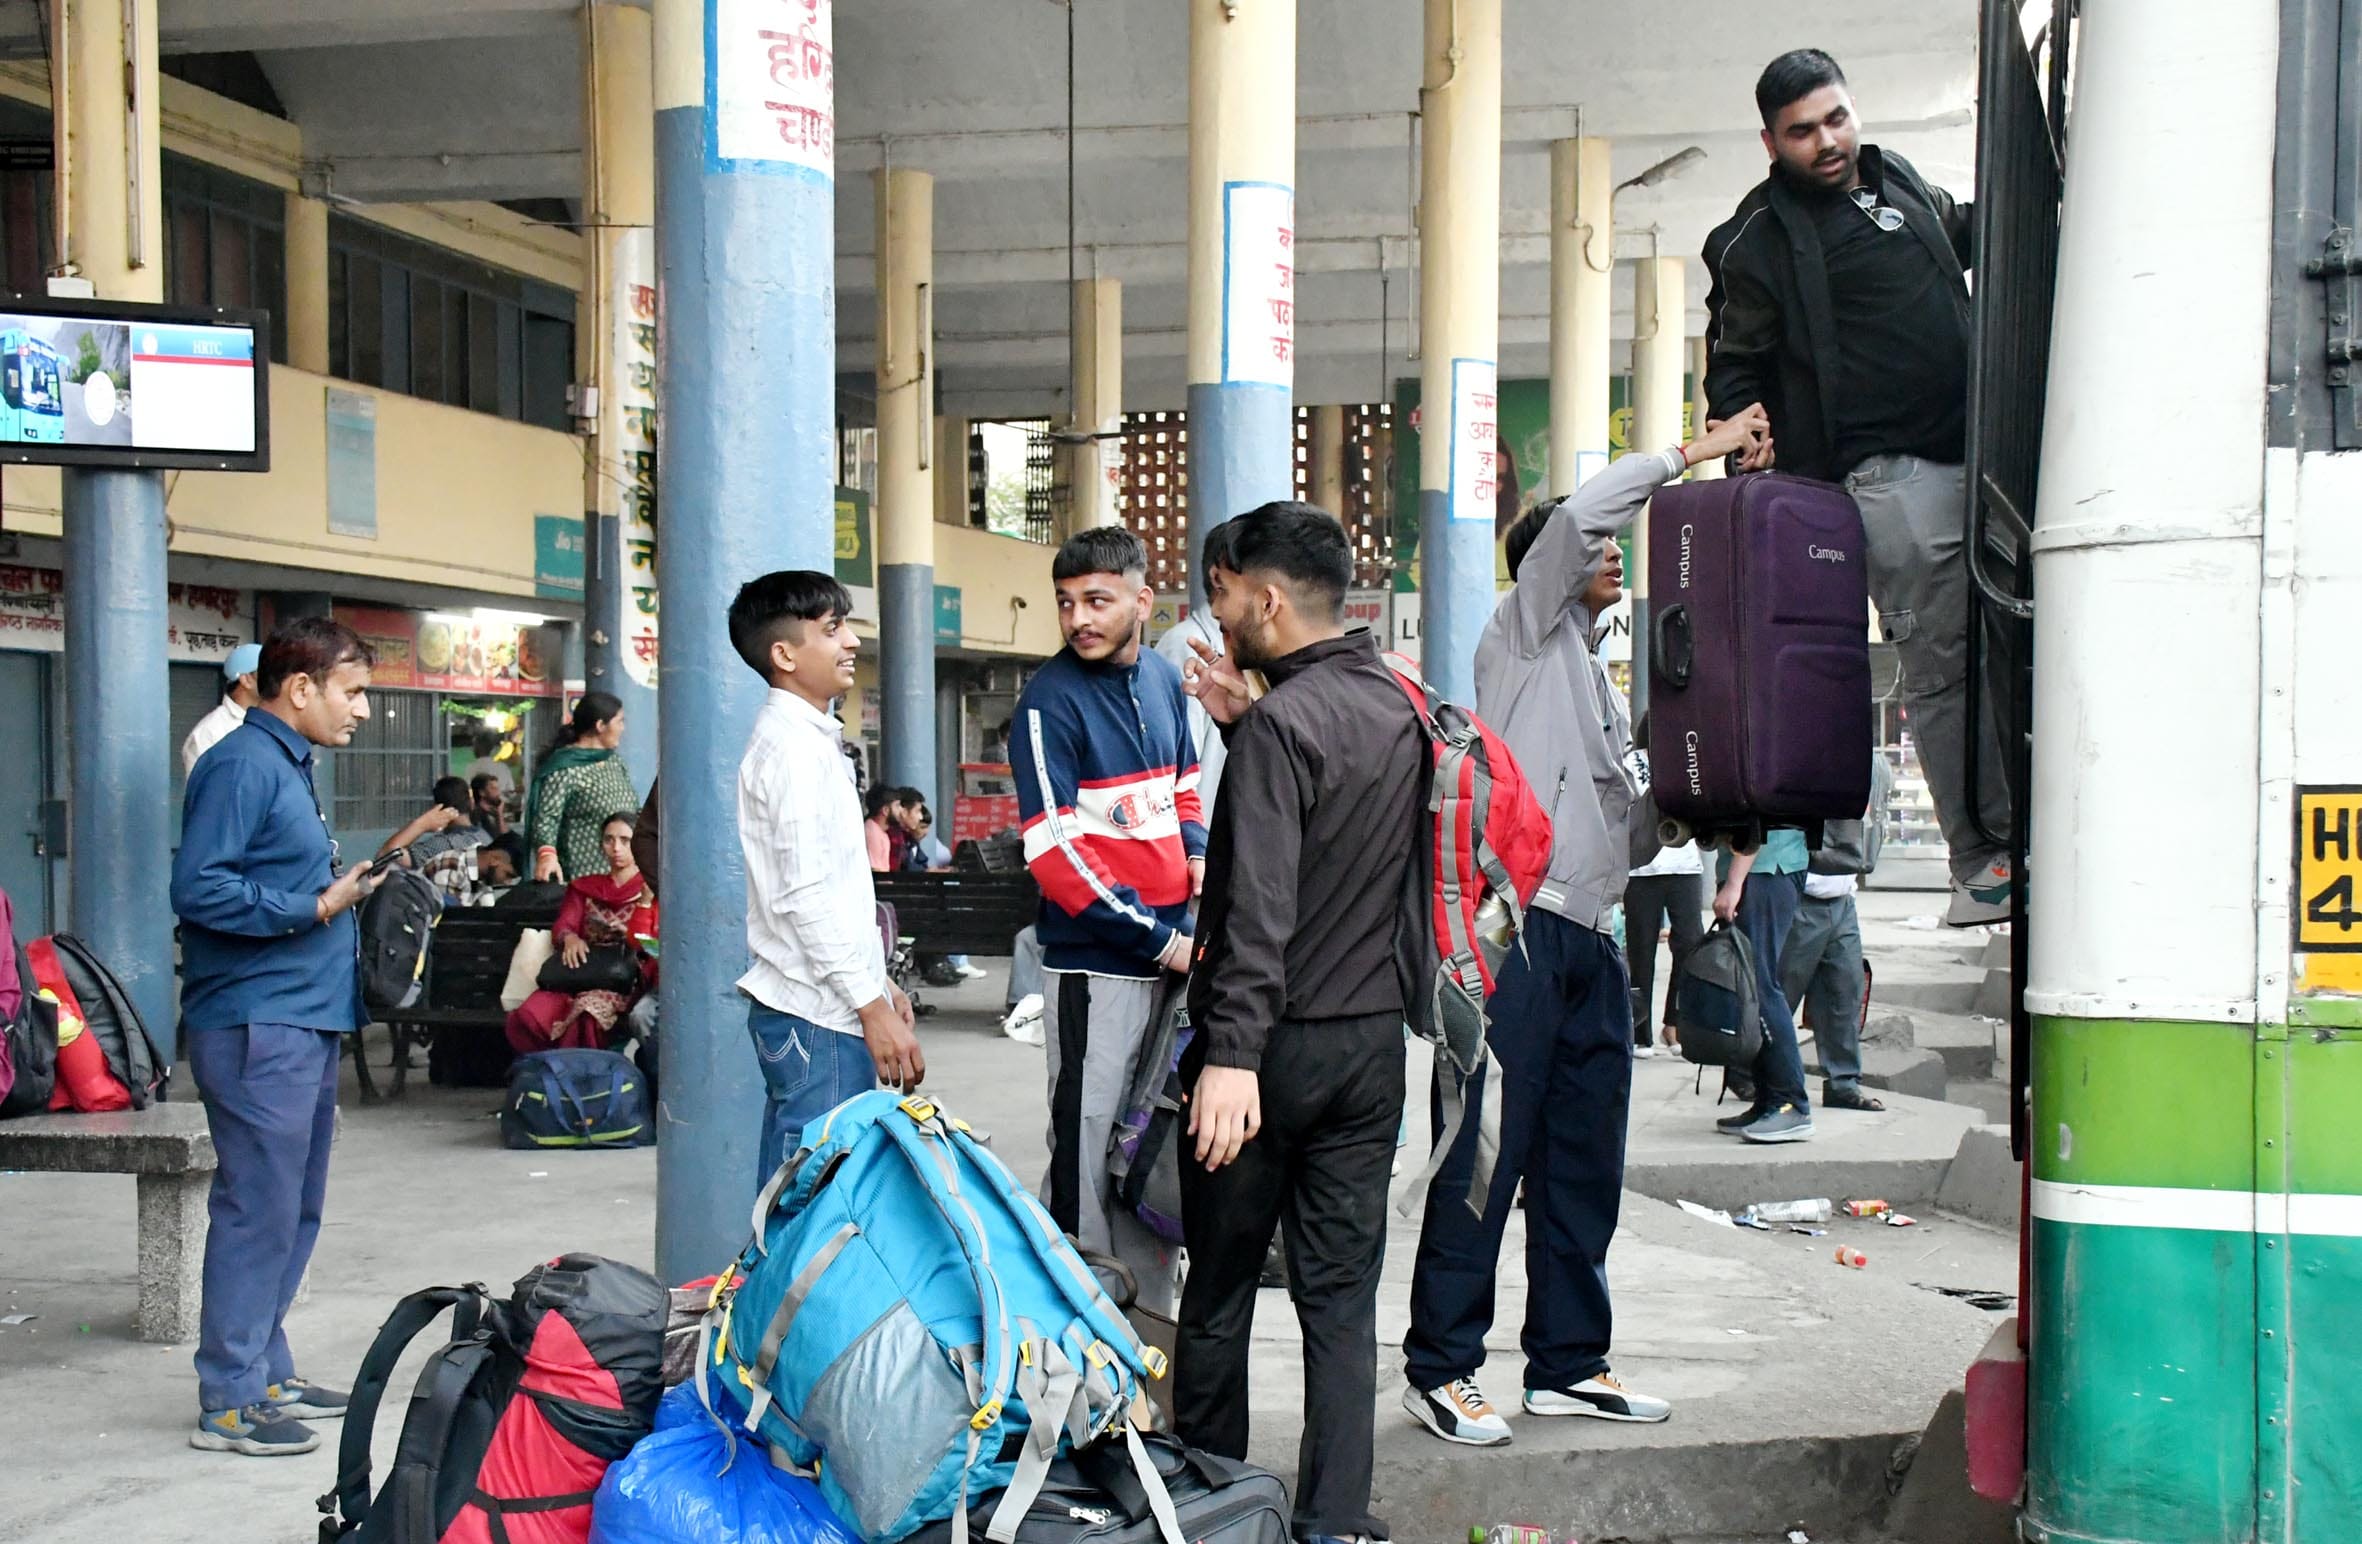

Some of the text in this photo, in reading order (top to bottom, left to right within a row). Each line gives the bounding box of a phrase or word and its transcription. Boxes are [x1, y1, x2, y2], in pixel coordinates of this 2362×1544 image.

[192, 339, 223, 356] HRTC
[1680, 523, 1693, 589] Campus
[1808, 544, 1846, 563] Campus
[1686, 730, 1701, 796] Campus
